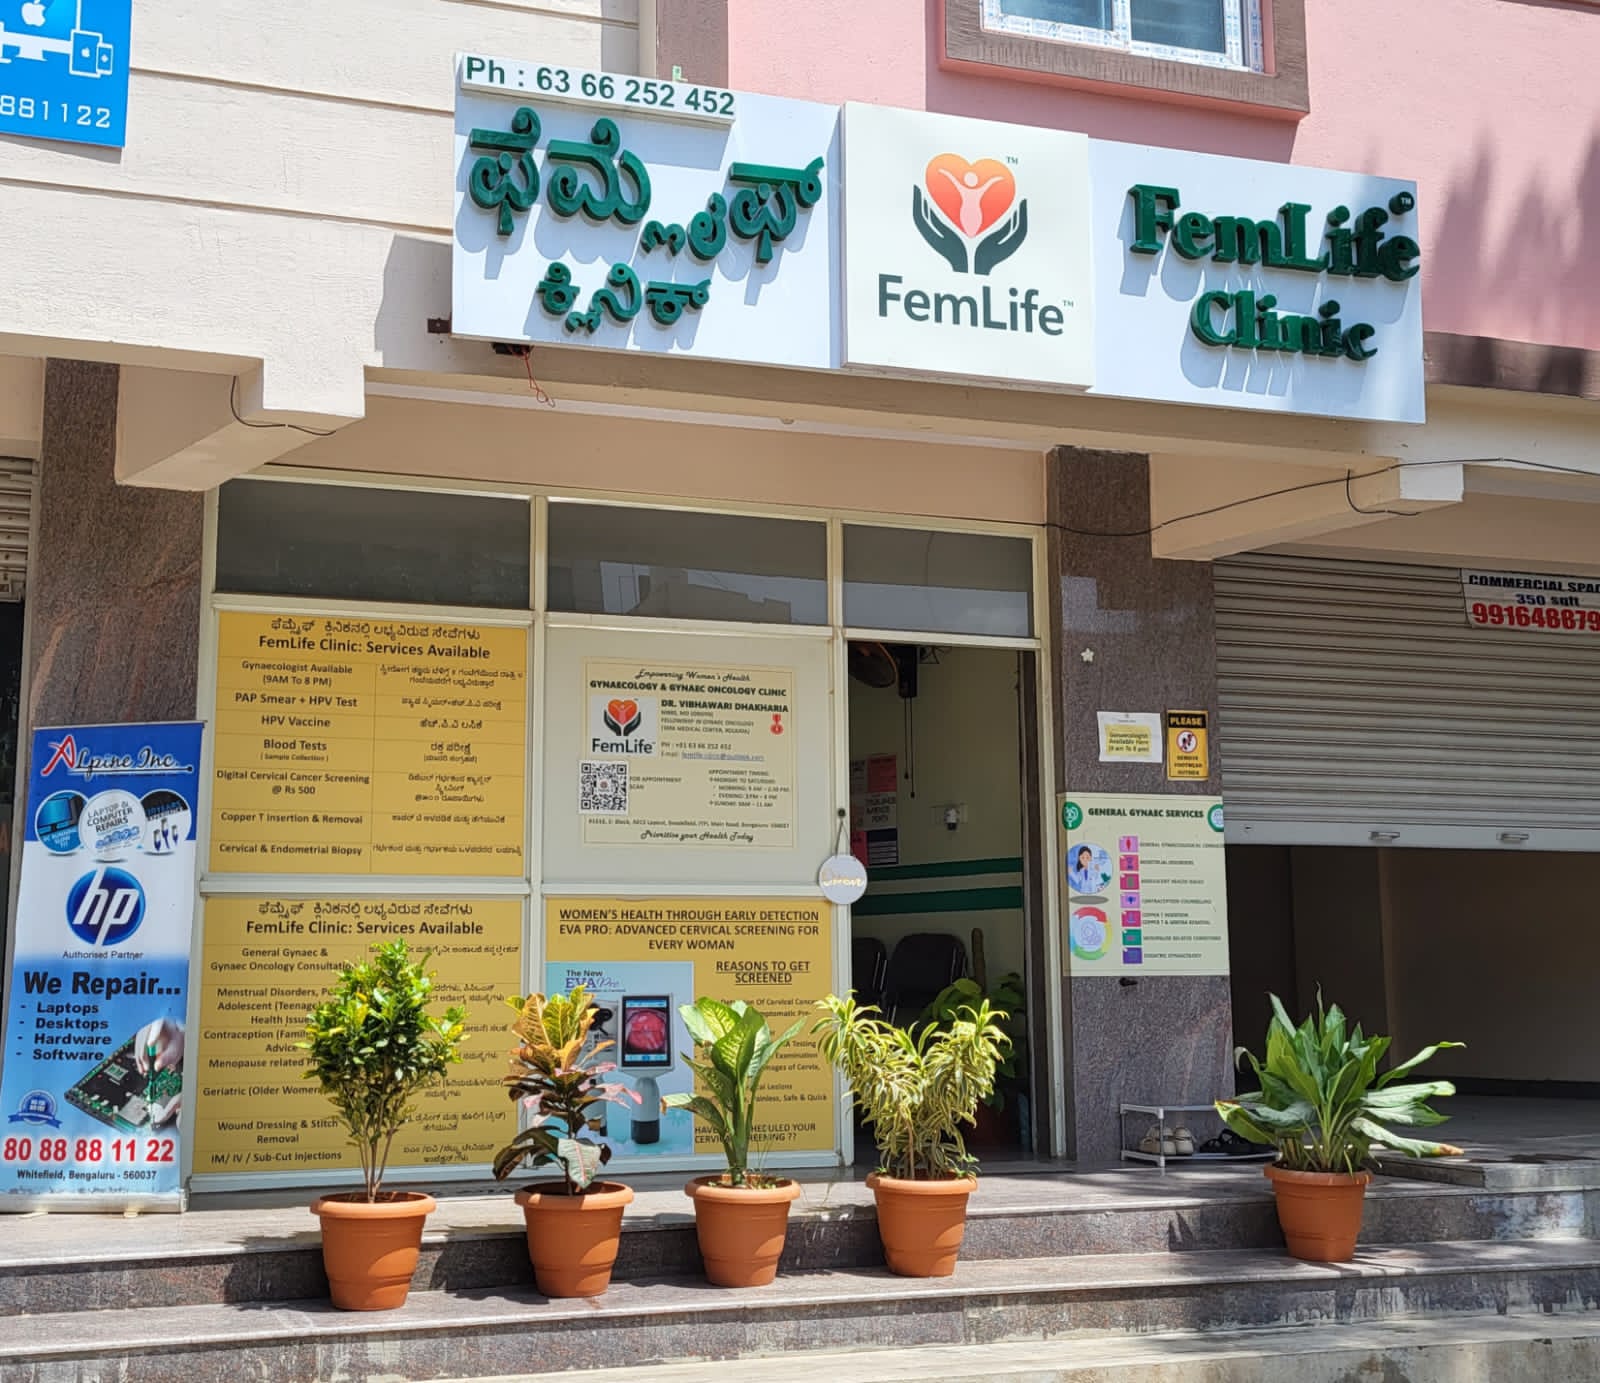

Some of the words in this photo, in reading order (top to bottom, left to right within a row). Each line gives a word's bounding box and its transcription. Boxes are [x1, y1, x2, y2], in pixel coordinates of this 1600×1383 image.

[466, 56, 505, 85] Ph
[536, 66, 571, 94] 63
[580, 73, 615, 100] 66
[625, 79, 675, 108] 252
[685, 88, 735, 116] 452
[1127, 184, 1421, 282] FemLife
[878, 273, 1065, 336] FemLife
[1190, 290, 1378, 361] Clinic
[1469, 574, 1566, 592] COMMERCIAL
[1515, 593, 1546, 606] 350
[259, 635, 316, 650] FemLife
[319, 638, 363, 653] Clinic:
[366, 642, 424, 656] Services
[427, 644, 491, 660] Available
[241, 660, 308, 674] Gynaecologist
[310, 664, 353, 674] Available
[262, 675, 289, 685] (9AM
[292, 676, 302, 685] To
[312, 677, 332, 688] PM)
[590, 680, 658, 691] GYNAECOLOGY
[669, 684, 705, 693] GYNAEC
[707, 685, 756, 695] ONCOLOGY
[758, 688, 787, 697] CLINIC
[235, 692, 257, 703] PAP
[260, 693, 296, 705] Smear
[309, 696, 333, 706] HPV
[335, 697, 358, 708] Test
[661, 699, 677, 708] DR.
[679, 700, 732, 710] VIBHAWARI
[734, 703, 789, 712] DHAKHARIA
[261, 715, 285, 725] HPV
[288, 716, 331, 728] Vaccine
[1170, 717, 1202, 725] PLEASE
[263, 739, 297, 750] Blood
[299, 740, 327, 751] Tests
[591, 737, 653, 754] FemLife
[216, 770, 248, 781] Digital
[250, 771, 288, 782] Cervical
[290, 772, 323, 782] Cancer
[324, 773, 371, 785] Screening
[271, 785, 282, 795] @
[285, 786, 296, 795] Rs
[298, 785, 316, 795] 500
[86, 807, 133, 827] COMPUTER
[220, 811, 257, 823] Copper
[267, 813, 310, 823] Insertion
[322, 814, 363, 825] Removal
[1087, 807, 1127, 816] GENERAL
[1129, 809, 1163, 817] GYNAEC
[1165, 810, 1204, 818] SERVICES
[95, 816, 129, 833] REPAIRS
[729, 831, 754, 843] Today
[219, 843, 258, 853] Cervical
[270, 844, 329, 854] Endometrial
[331, 845, 363, 857] Biopsy
[72, 866, 140, 946] hp
[621, 909, 663, 920] HEALTH
[666, 909, 722, 921] THROUGH
[724, 911, 757, 921] EARLY
[759, 911, 819, 921] DETECTION
[246, 920, 304, 934] FemLife
[308, 921, 352, 934] Clinic:
[356, 921, 415, 934] Services
[419, 921, 484, 935] Available
[559, 924, 581, 935] EVA
[584, 925, 612, 935] PRO:
[615, 925, 677, 936] ADVANCED
[679, 925, 731, 936] CERVICAL
[734, 926, 795, 936] SCREENING
[798, 926, 819, 936] FOR
[648, 939, 683, 950] EVERY
[686, 940, 735, 950] WOMAN
[62, 950, 108, 960] Authorised
[241, 948, 280, 957] General
[282, 948, 317, 961] Gynaec
[319, 948, 328, 957] &
[210, 962, 247, 973] Gynaec
[249, 961, 294, 973] Oncology
[566, 969, 581, 977] The
[583, 969, 603, 977] New
[716, 961, 768, 971] REASONS
[771, 962, 786, 972] TO
[789, 962, 810, 972] GET
[565, 977, 597, 989] EVA
[735, 972, 792, 984] SCREENED
[24, 971, 62, 995] We
[72, 971, 181, 1000] Repair...
[217, 988, 267, 998] Menstrual
[270, 988, 319, 998] Disorders,
[217, 1002, 272, 1011] Adolescent
[766, 998, 794, 1006] Cervical
[37, 1002, 99, 1016] Laptops
[36, 1017, 109, 1031] Desktops
[250, 1015, 283, 1025] Health
[34, 1033, 112, 1045] Hardware
[203, 1031, 273, 1041] Contraception
[33, 1048, 104, 1061] Software
[265, 1044, 298, 1053] Advice
[208, 1059, 267, 1070] Menopause
[269, 1058, 304, 1067] related
[203, 1087, 246, 1097] Geriatric
[248, 1087, 279, 1097] (Older
[217, 1120, 253, 1131] Wound
[256, 1120, 298, 1131] Dressing
[300, 1120, 308, 1129] &
[311, 1119, 338, 1128] Stitch
[792, 1123, 816, 1132] YOUR
[256, 1134, 300, 1144] Removal
[4, 1137, 32, 1161] 80
[39, 1138, 67, 1161] 88
[75, 1138, 103, 1162] 88
[112, 1138, 136, 1162] 11
[146, 1139, 174, 1162] 22
[253, 1152, 292, 1163] Sub-Cut
[294, 1150, 342, 1162] Injections
[17, 1169, 66, 1180] Whitefield,
[69, 1170, 115, 1181] Bengaluru
[123, 1170, 157, 1180] 560037
